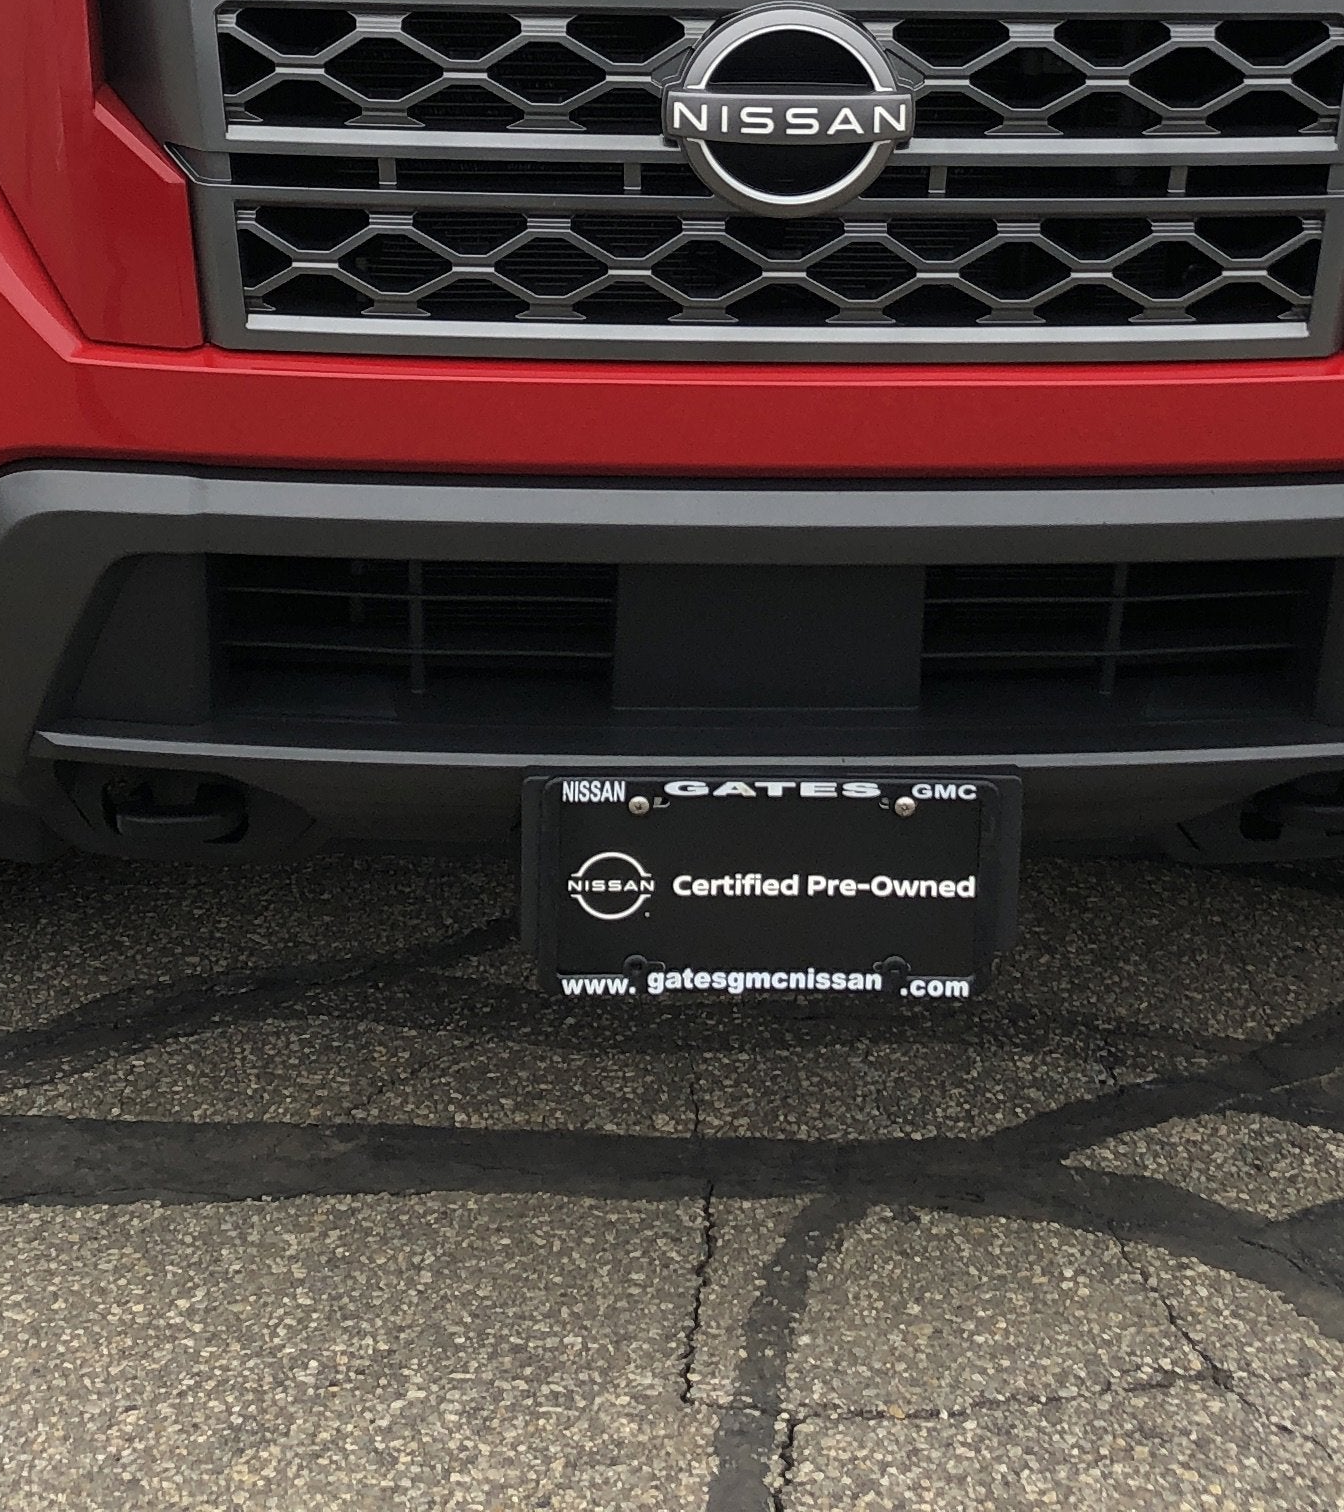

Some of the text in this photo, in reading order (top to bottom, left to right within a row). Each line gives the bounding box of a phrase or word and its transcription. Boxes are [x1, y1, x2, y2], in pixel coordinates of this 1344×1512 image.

[672, 100, 906, 136] NISSAN
[561, 780, 978, 803] NISSAN GATES GMC
[567, 879, 655, 892] NISSAN
[672, 873, 977, 898] Certified Pre-Owned
[646, 967, 883, 995] gatesgmcnissan
